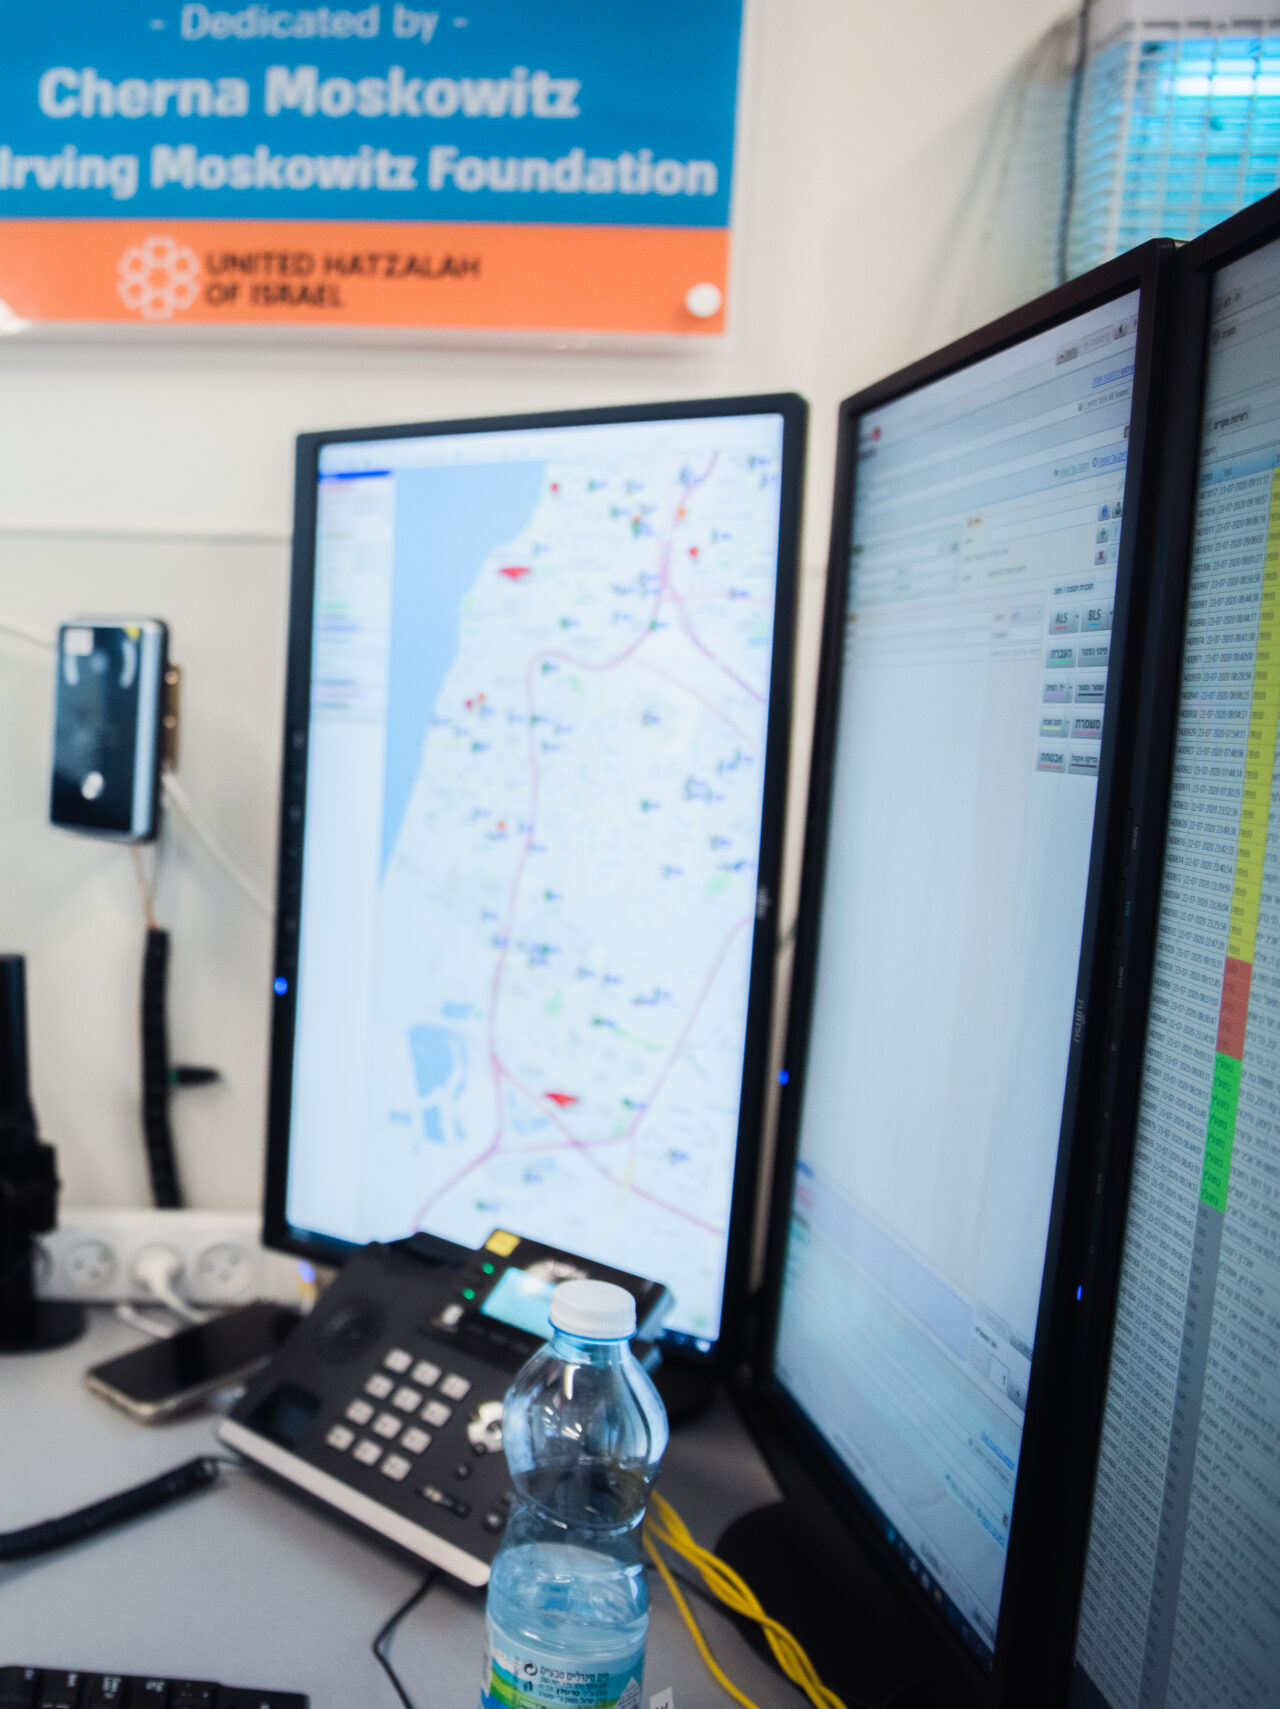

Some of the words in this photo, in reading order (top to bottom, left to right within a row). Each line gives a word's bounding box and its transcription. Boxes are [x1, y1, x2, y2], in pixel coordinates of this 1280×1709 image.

[181, 3, 380, 39] Dedicated
[393, 4, 441, 44] by
[37, 68, 248, 118] Cherna
[264, 67, 582, 118] Moskowitz
[151, 145, 417, 191] Moskowitz
[428, 146, 718, 195] Foundation
[205, 253, 317, 279] UNITED
[323, 255, 482, 281] HATZALAH
[205, 283, 241, 307] OF
[248, 285, 347, 308] ISRAEL
[1055, 612, 1069, 624] ALS
[1088, 609, 1102, 621] BLS
[1075, 719, 1101, 729] משמרת
